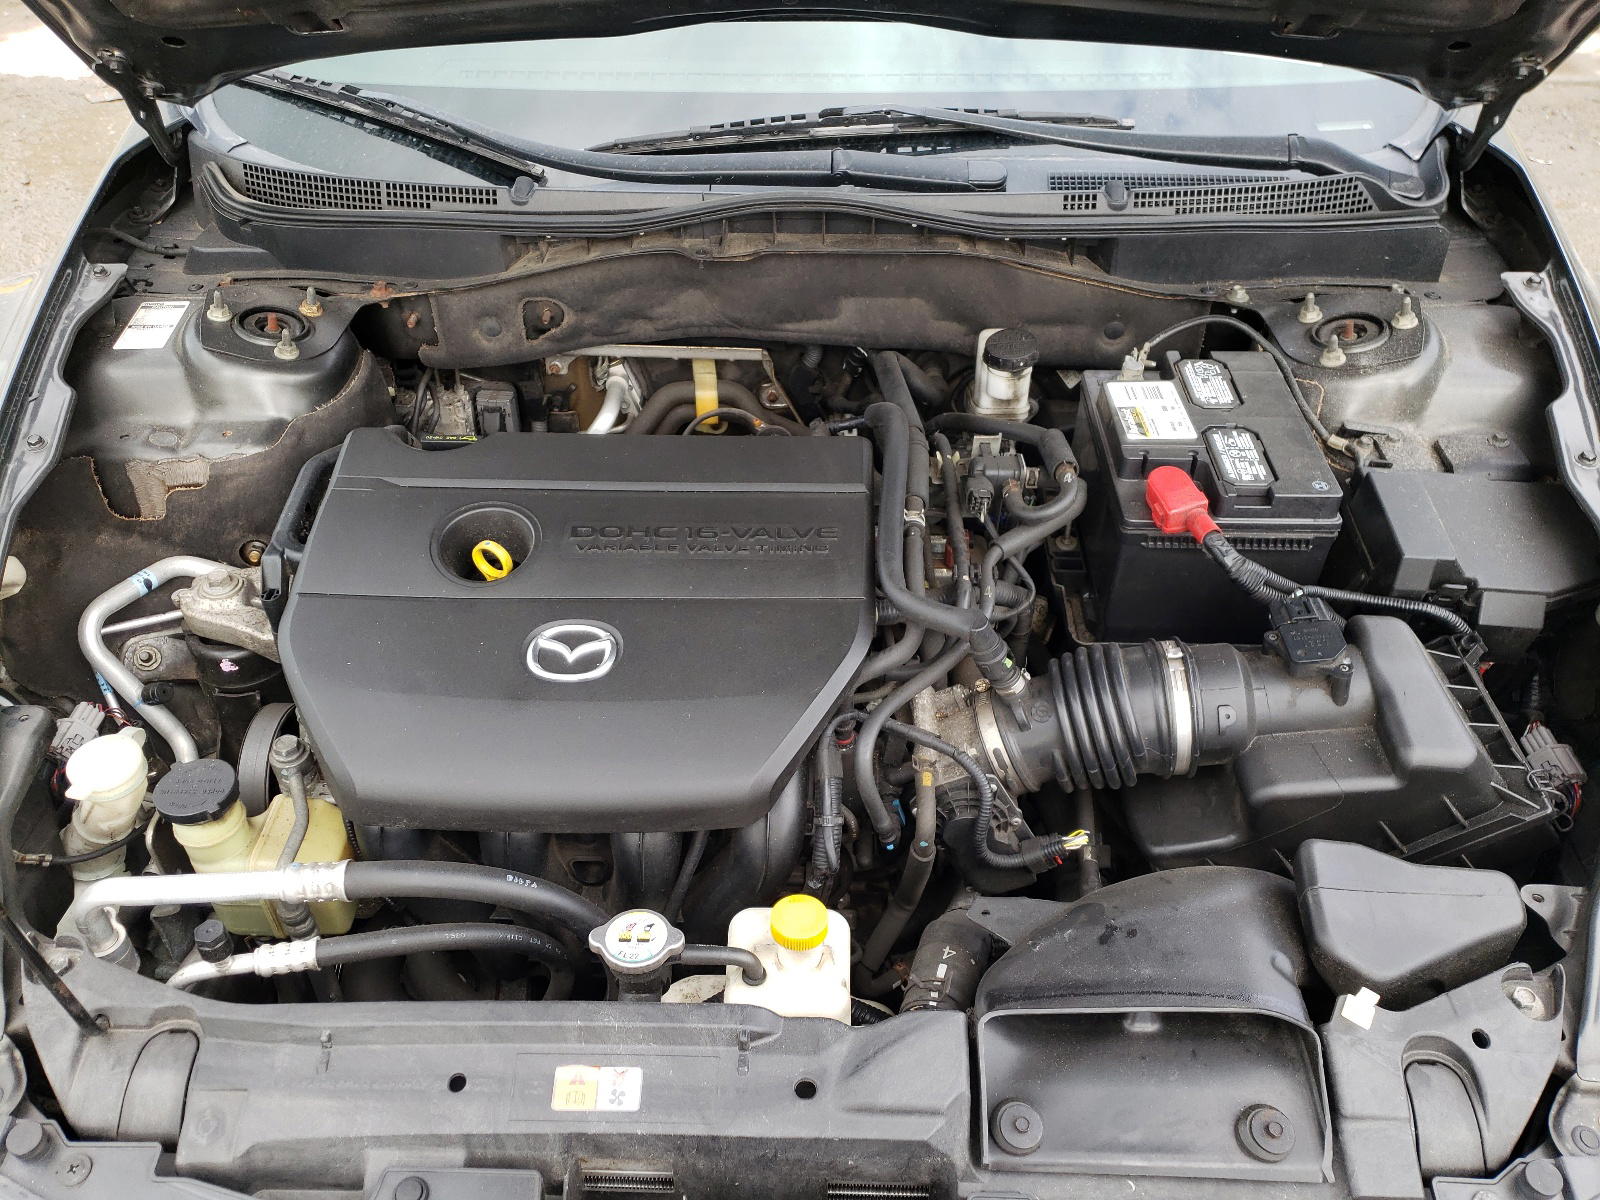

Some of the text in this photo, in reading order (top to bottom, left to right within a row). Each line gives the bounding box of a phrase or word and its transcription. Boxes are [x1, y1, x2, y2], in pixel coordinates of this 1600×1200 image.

[570, 526, 839, 541] DOHC 16-VALVE
[576, 542, 830, 555] VARIABLE VALVE TIMING
[942, 945, 957, 960] 4
